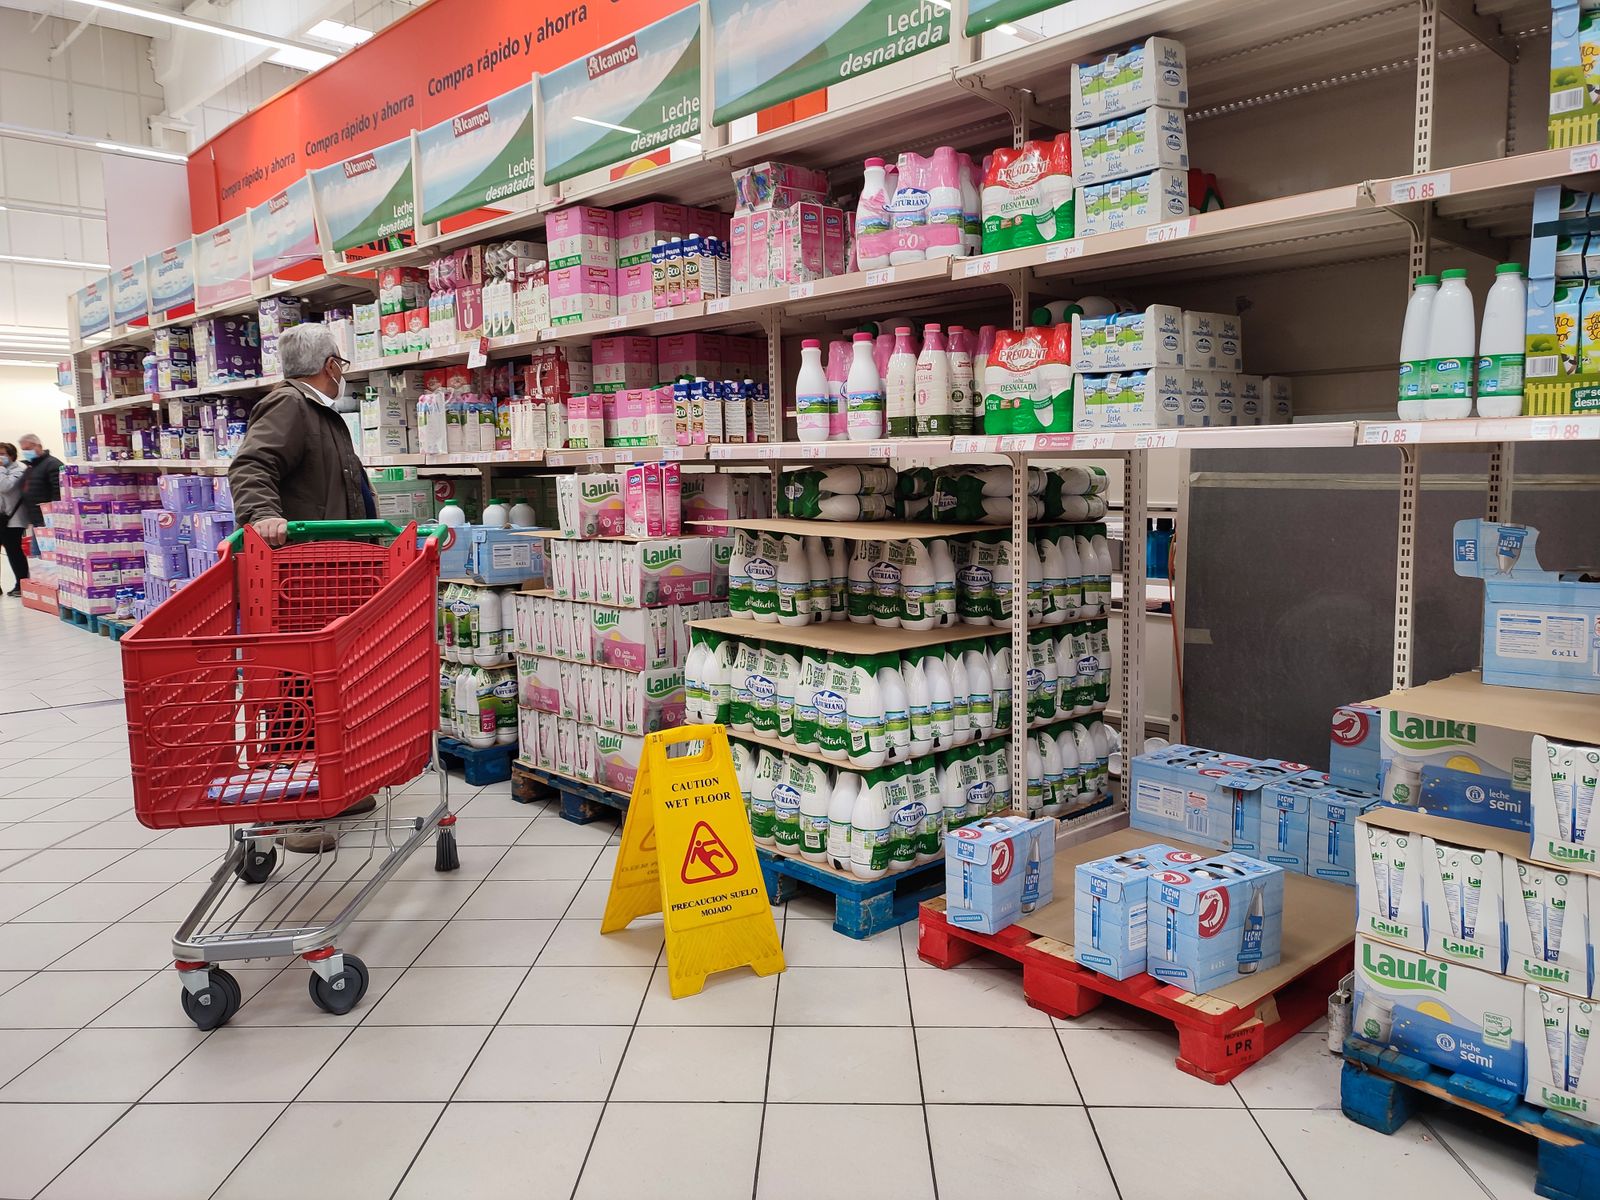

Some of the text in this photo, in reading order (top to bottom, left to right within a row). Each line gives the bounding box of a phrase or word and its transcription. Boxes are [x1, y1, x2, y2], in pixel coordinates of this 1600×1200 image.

[887, 0, 945, 37] Leche
[428, 3, 588, 97] Compra rápido y ahorra
[839, 23, 944, 77] desnatada
[588, 43, 637, 77] Alcampo
[662, 97, 700, 123] Leche
[305, 94, 414, 157] Compra rápido y ahorra
[454, 111, 490, 135] Alcampo
[631, 116, 699, 152] desnatada
[221, 152, 296, 201] Compra rápido y ahorra
[508, 157, 534, 179] Leche
[485, 175, 534, 202] desnatada
[1408, 182, 1435, 201] 0.85
[393, 201, 414, 218] Leche
[1000, 199, 1040, 212] DESNATADA
[377, 215, 413, 237] desnatada
[1158, 227, 1178, 240] 0.71
[999, 348, 1048, 361] PRESIDENT
[1438, 361, 1459, 371] Celta
[1000, 382, 1037, 393] DESNATADA
[1381, 429, 1406, 444] 0.85
[1549, 424, 1580, 440] 0.88
[1146, 435, 1166, 448] 0.71
[581, 479, 620, 498] Lauki
[682, 479, 705, 494] auki
[714, 543, 733, 560] Lau
[1464, 540, 1475, 561] LECHE
[1500, 539, 1521, 548] LECHE
[643, 544, 681, 564] Lauki
[593, 608, 620, 624] Lauki
[1551, 648, 1557, 656] 6
[1573, 649, 1579, 658] L
[518, 655, 539, 671] Lauki
[647, 671, 685, 694] Lauki
[1389, 708, 1477, 744] Lauki
[596, 731, 623, 749] Lauki
[671, 776, 720, 792] CAUTION
[665, 791, 731, 810] WET FLOOR
[1278, 794, 1295, 804] LECHE
[1489, 788, 1510, 801] leche
[1328, 805, 1346, 815] LECHE
[1489, 800, 1522, 815] semi
[958, 842, 975, 853] LECHE
[1548, 841, 1596, 863] Lauki
[1025, 874, 1039, 885] LECHE
[1092, 877, 1107, 888] LECHE
[671, 887, 758, 911] PRECAUCION SUELO
[1162, 886, 1180, 898] LECHE
[701, 904, 732, 917] MOJADO
[1244, 930, 1262, 942] LECHE
[1370, 916, 1408, 938] Lauki
[1443, 937, 1484, 959] Lauki
[1548, 949, 1559, 959] PLS
[1362, 943, 1448, 992] Lauki
[1524, 959, 1570, 983] Lauki
[1226, 1038, 1253, 1057] LPR
[1460, 1039, 1481, 1053] leche
[1460, 1050, 1493, 1069] semi
[1541, 1086, 1588, 1113] Lauki
